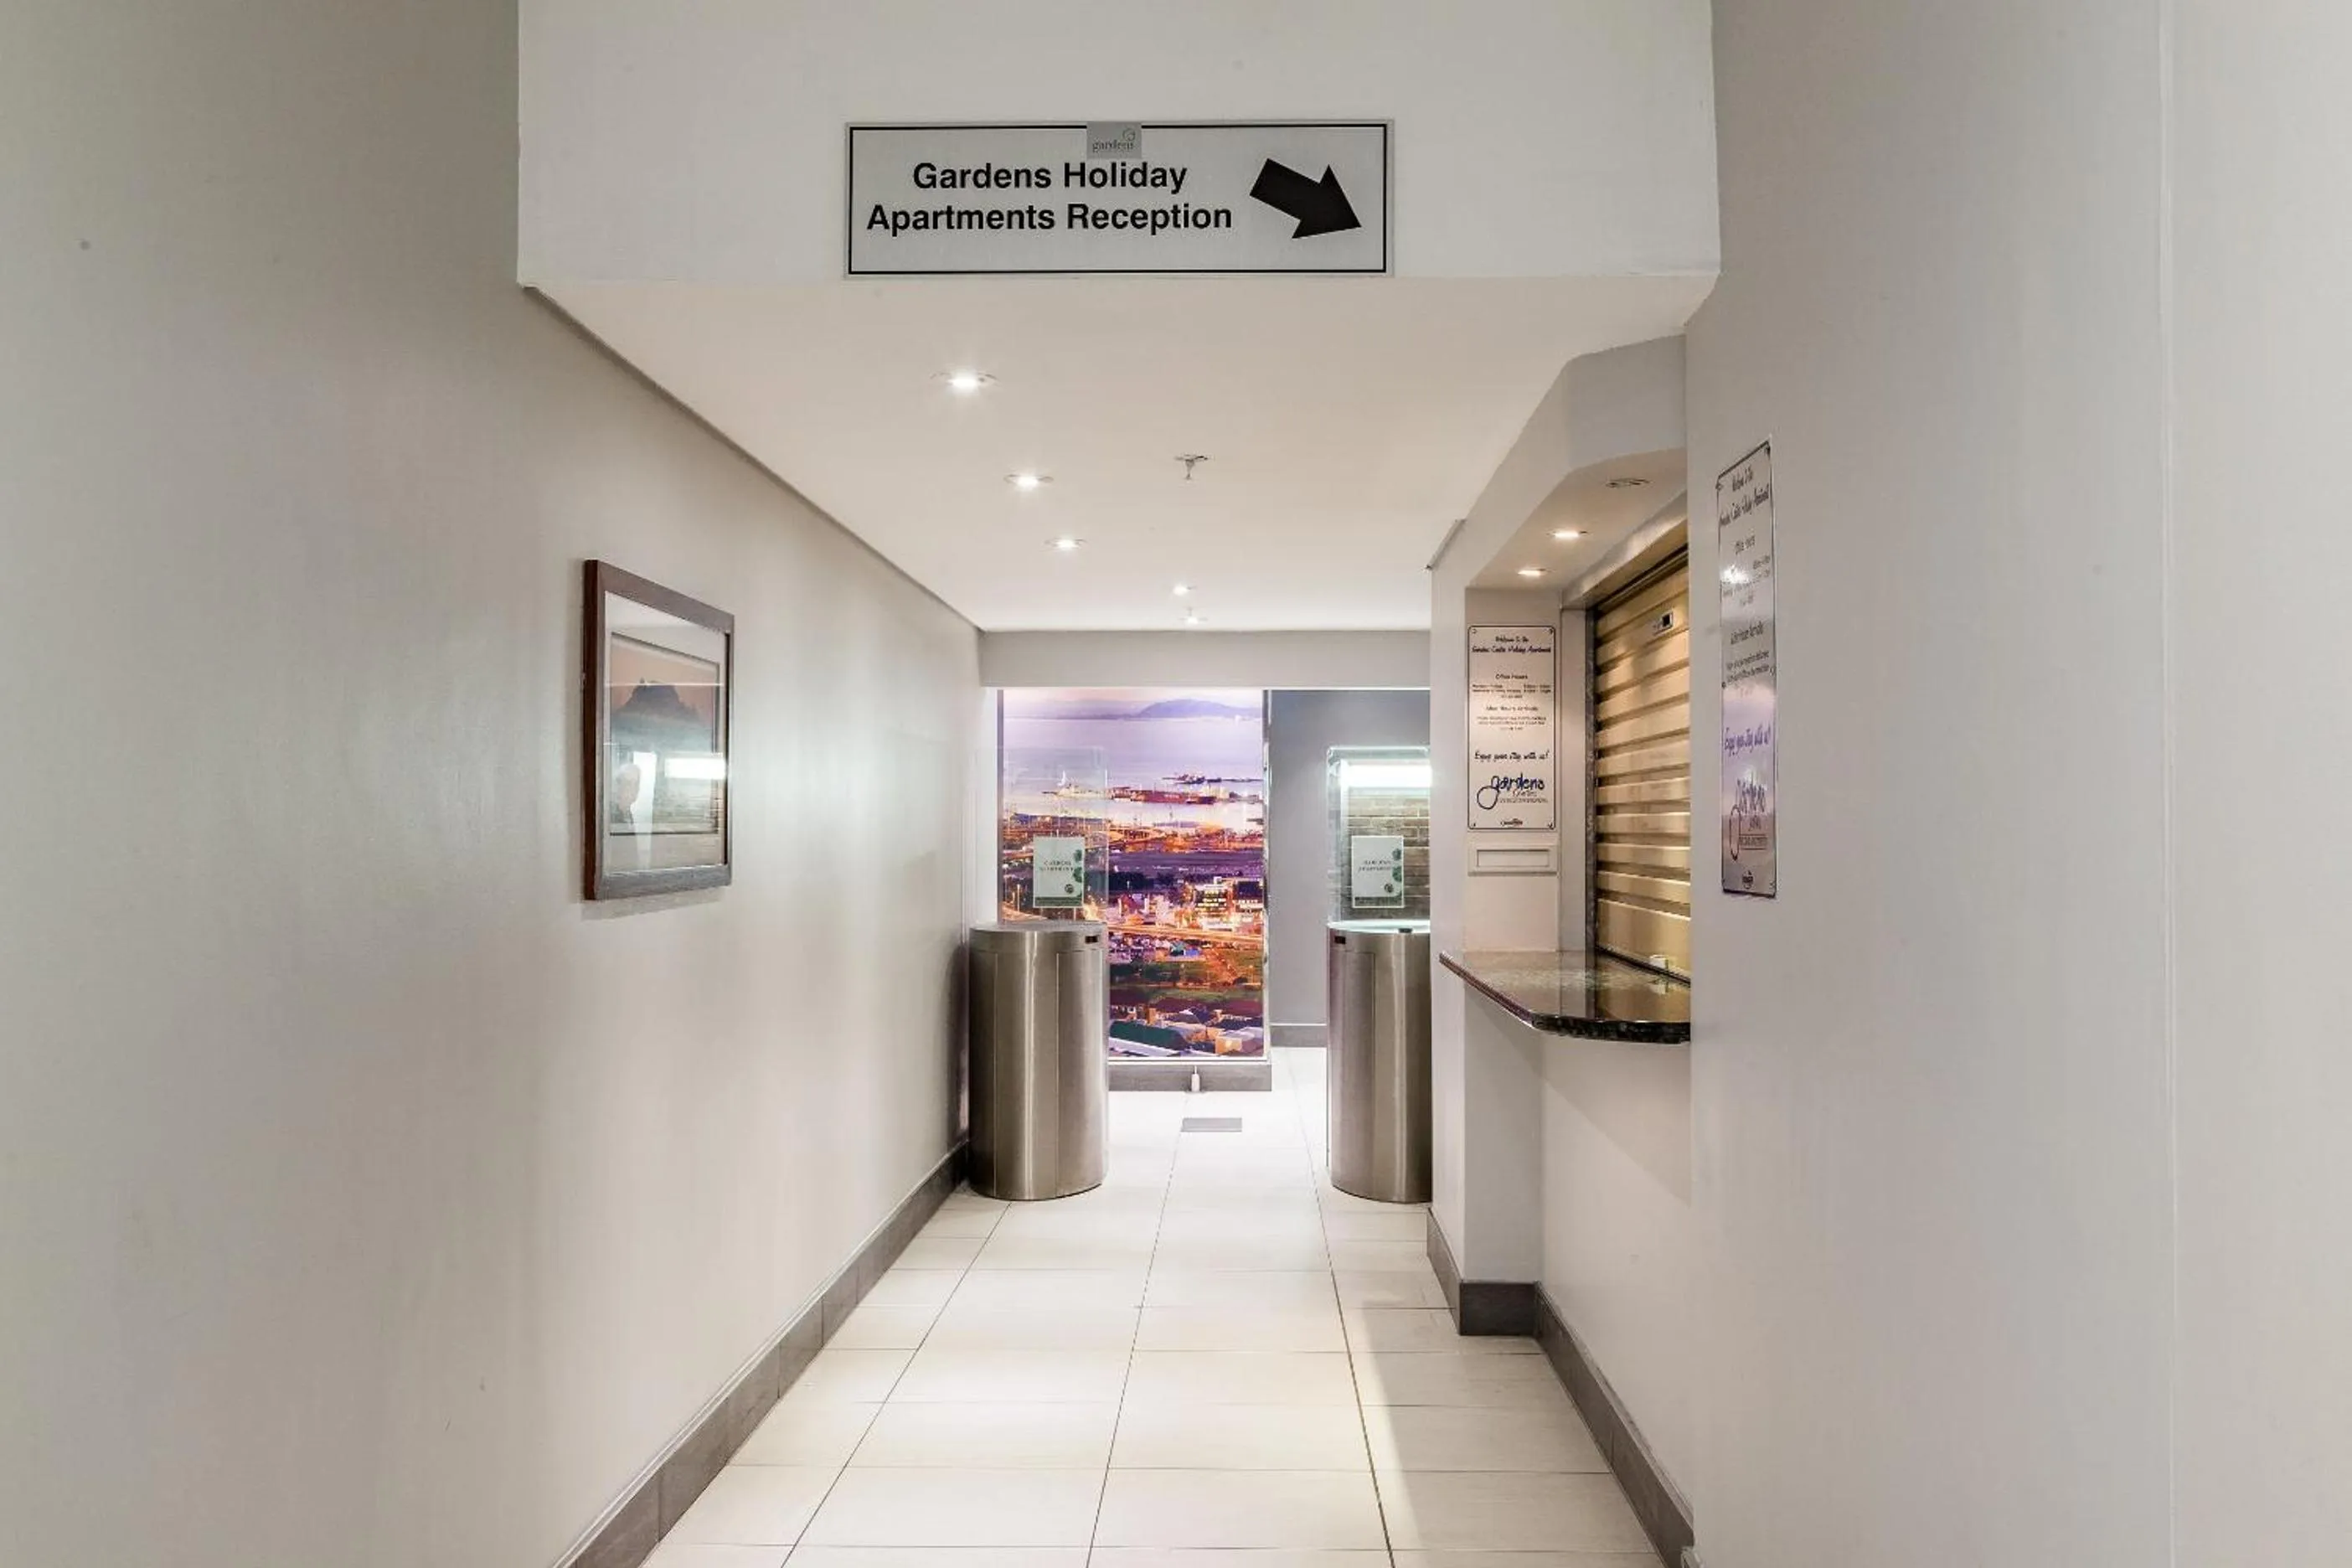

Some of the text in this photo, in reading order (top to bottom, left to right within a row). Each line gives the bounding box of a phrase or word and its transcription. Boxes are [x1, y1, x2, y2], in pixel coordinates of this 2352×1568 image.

[914, 162, 1188, 194] Gardens Holiday
[867, 203, 1231, 237] Apartments Reception
